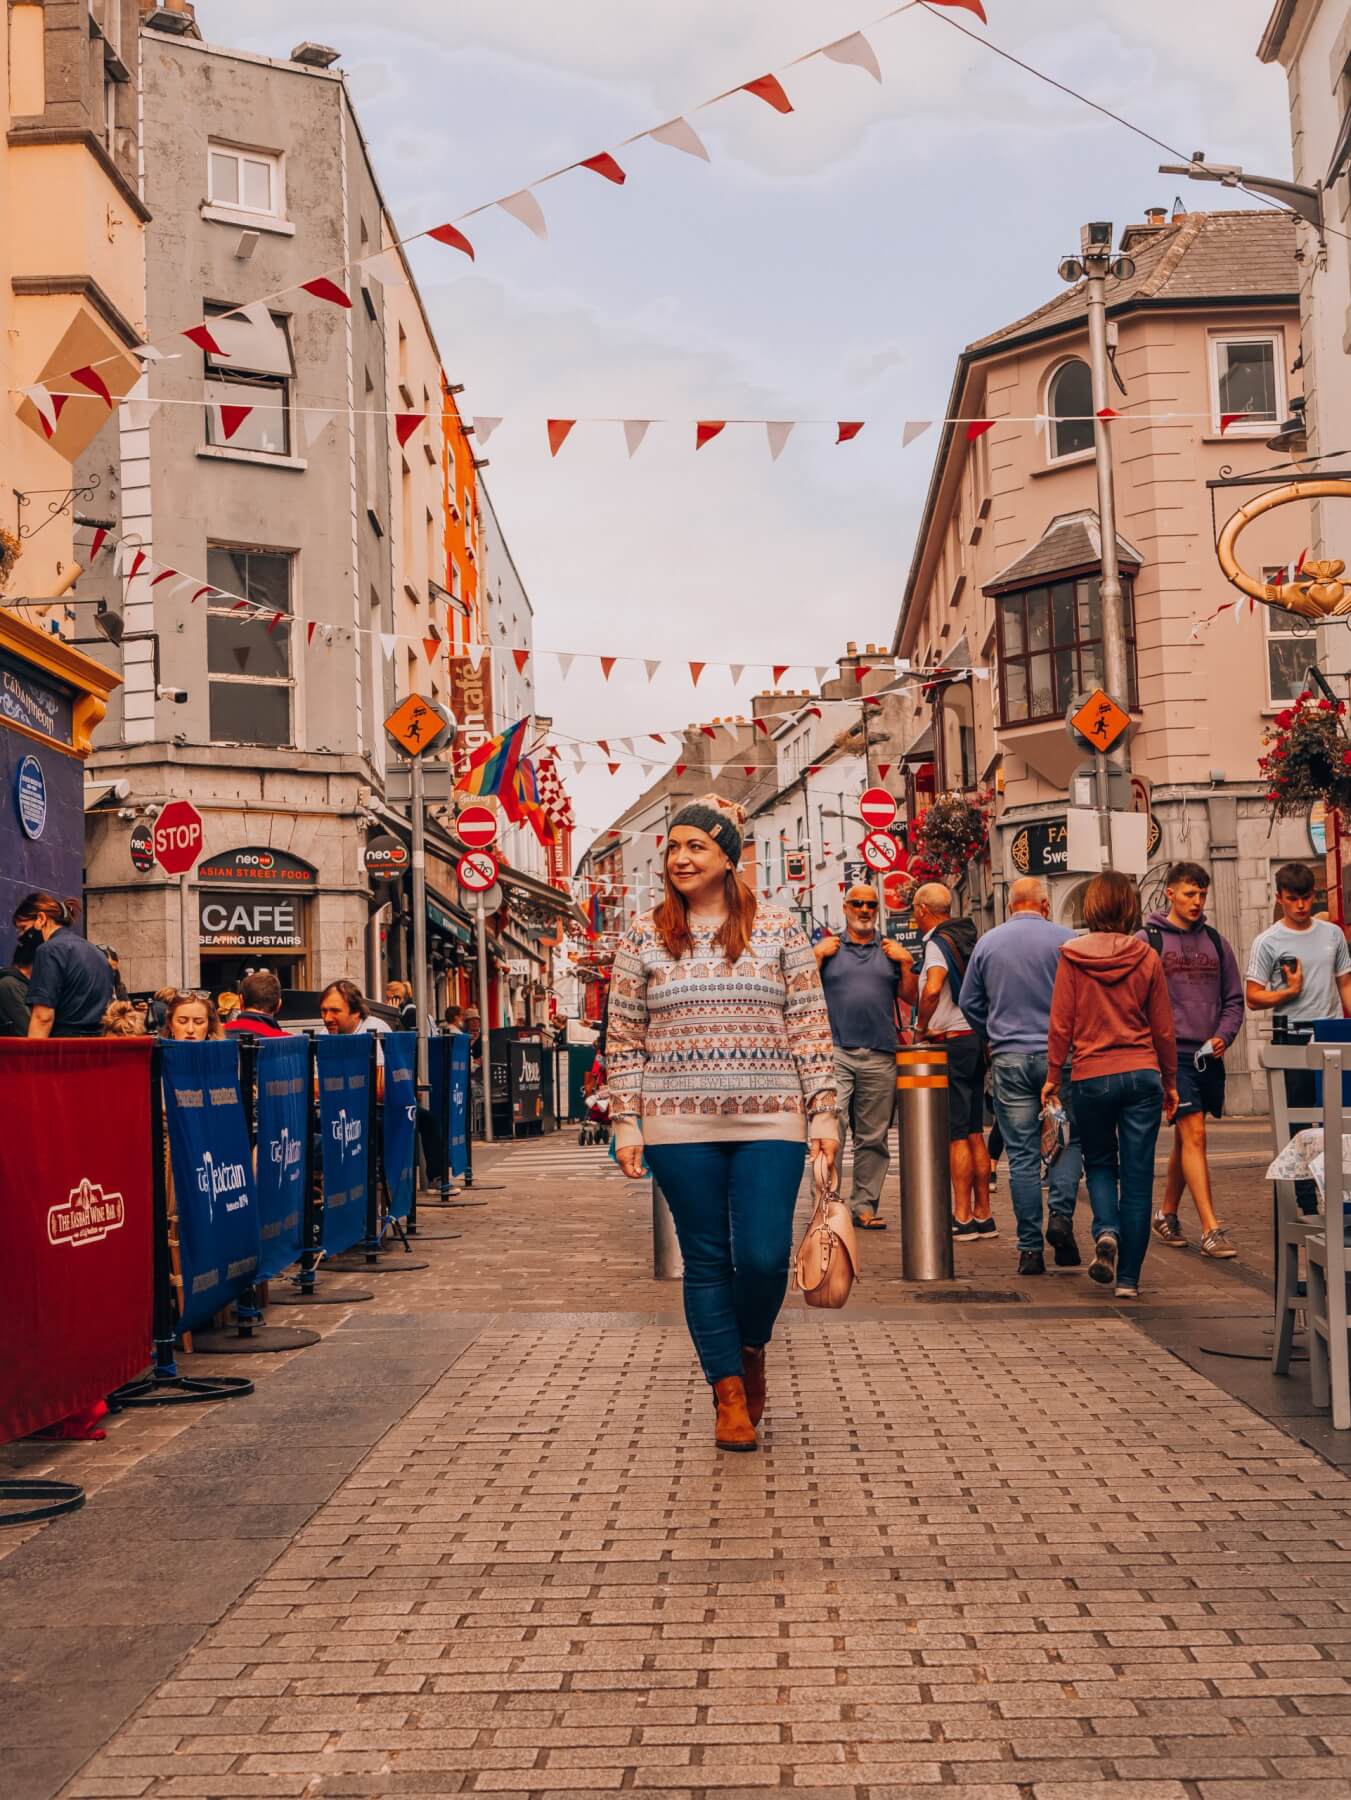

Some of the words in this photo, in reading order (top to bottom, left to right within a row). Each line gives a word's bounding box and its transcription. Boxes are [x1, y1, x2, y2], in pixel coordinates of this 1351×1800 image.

[156, 823, 200, 852] STOP
[1048, 826, 1068, 843] FA
[131, 838, 145, 850] neo
[235, 855, 259, 865] neo
[366, 850, 391, 860] neo
[1042, 847, 1068, 865] Swe
[199, 867, 233, 877] ASIAN
[236, 868, 277, 878] STREET
[281, 869, 311, 880] FOOD
[201, 901, 295, 932] CAFÉ
[199, 935, 246, 945] SEATING
[248, 936, 302, 945] UPSTAIRS
[895, 932, 905, 941] TO
[905, 931, 917, 940] LET
[57, 1214, 70, 1233] THE
[90, 1206, 105, 1224] WINE
